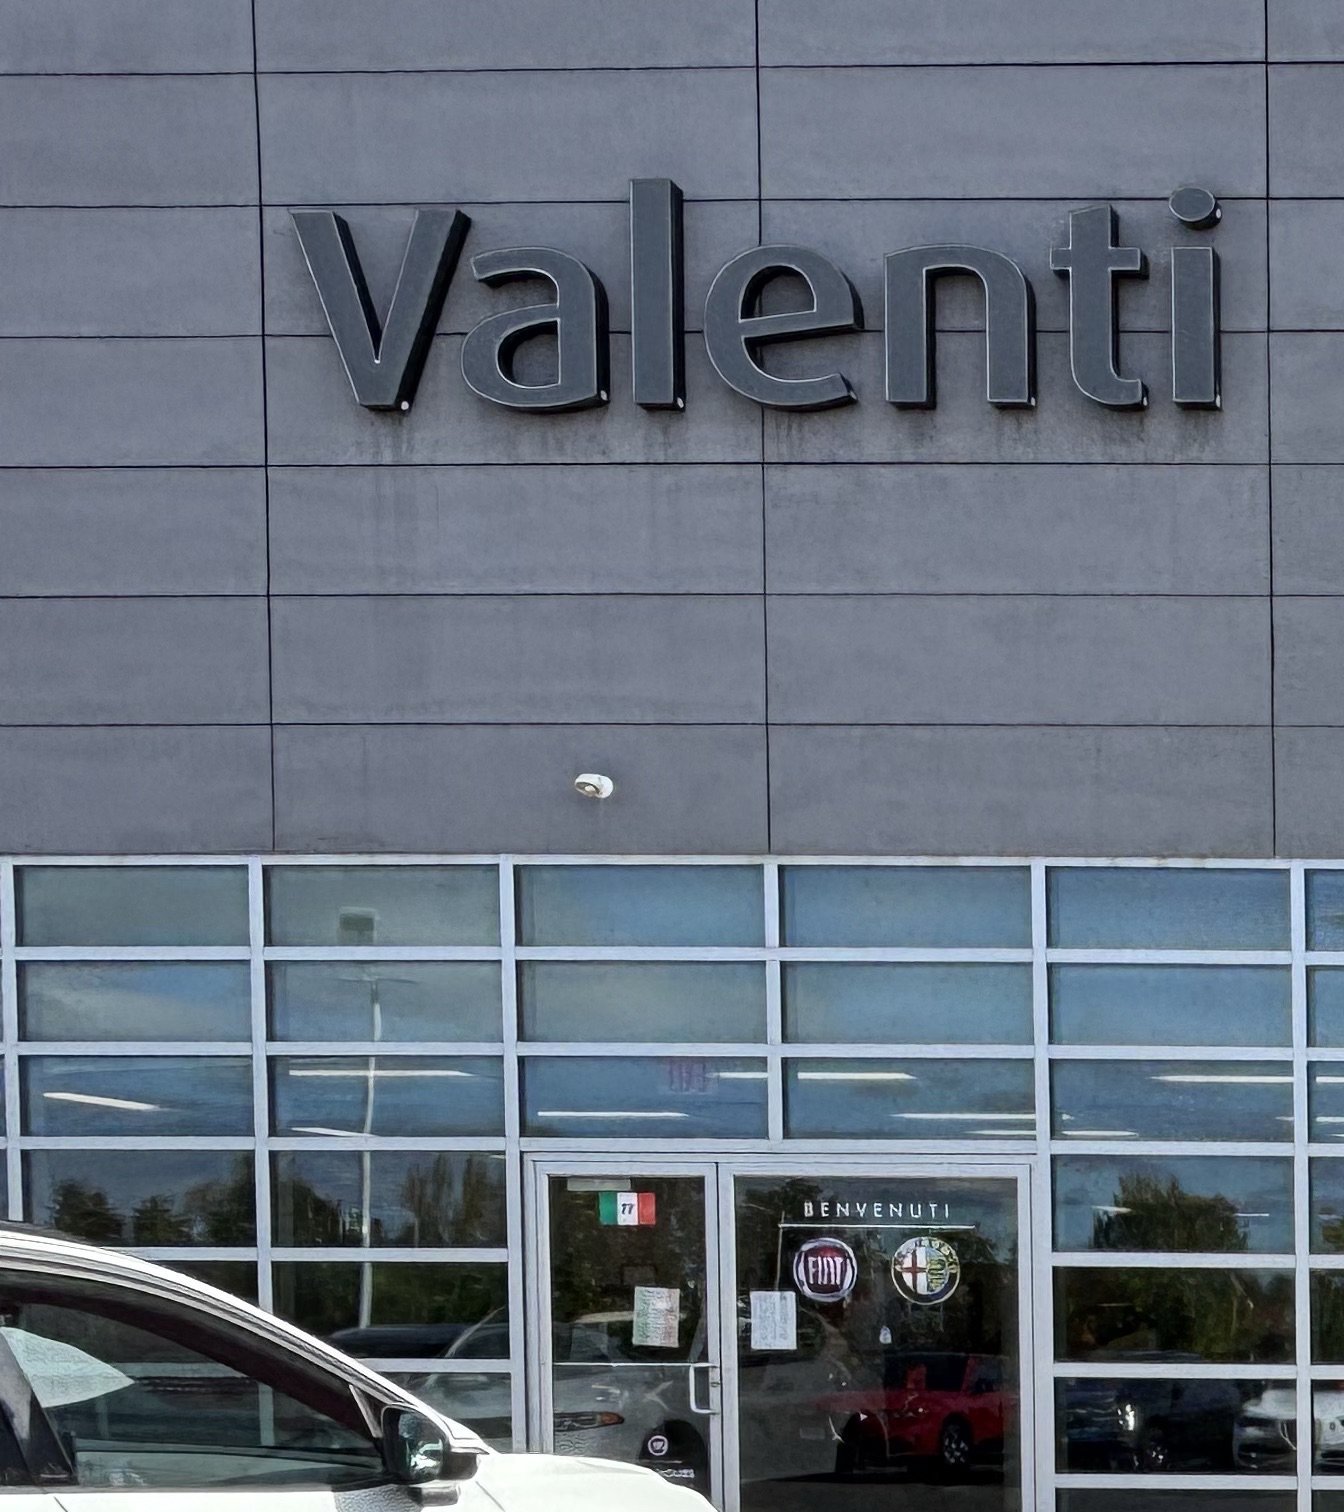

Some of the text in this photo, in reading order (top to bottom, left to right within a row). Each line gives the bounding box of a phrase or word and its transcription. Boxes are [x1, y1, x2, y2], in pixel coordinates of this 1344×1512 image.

[288, 178, 1223, 412] Valenti
[803, 1201, 950, 1220] BENVENUTI
[808, 1256, 844, 1287] FIAT
